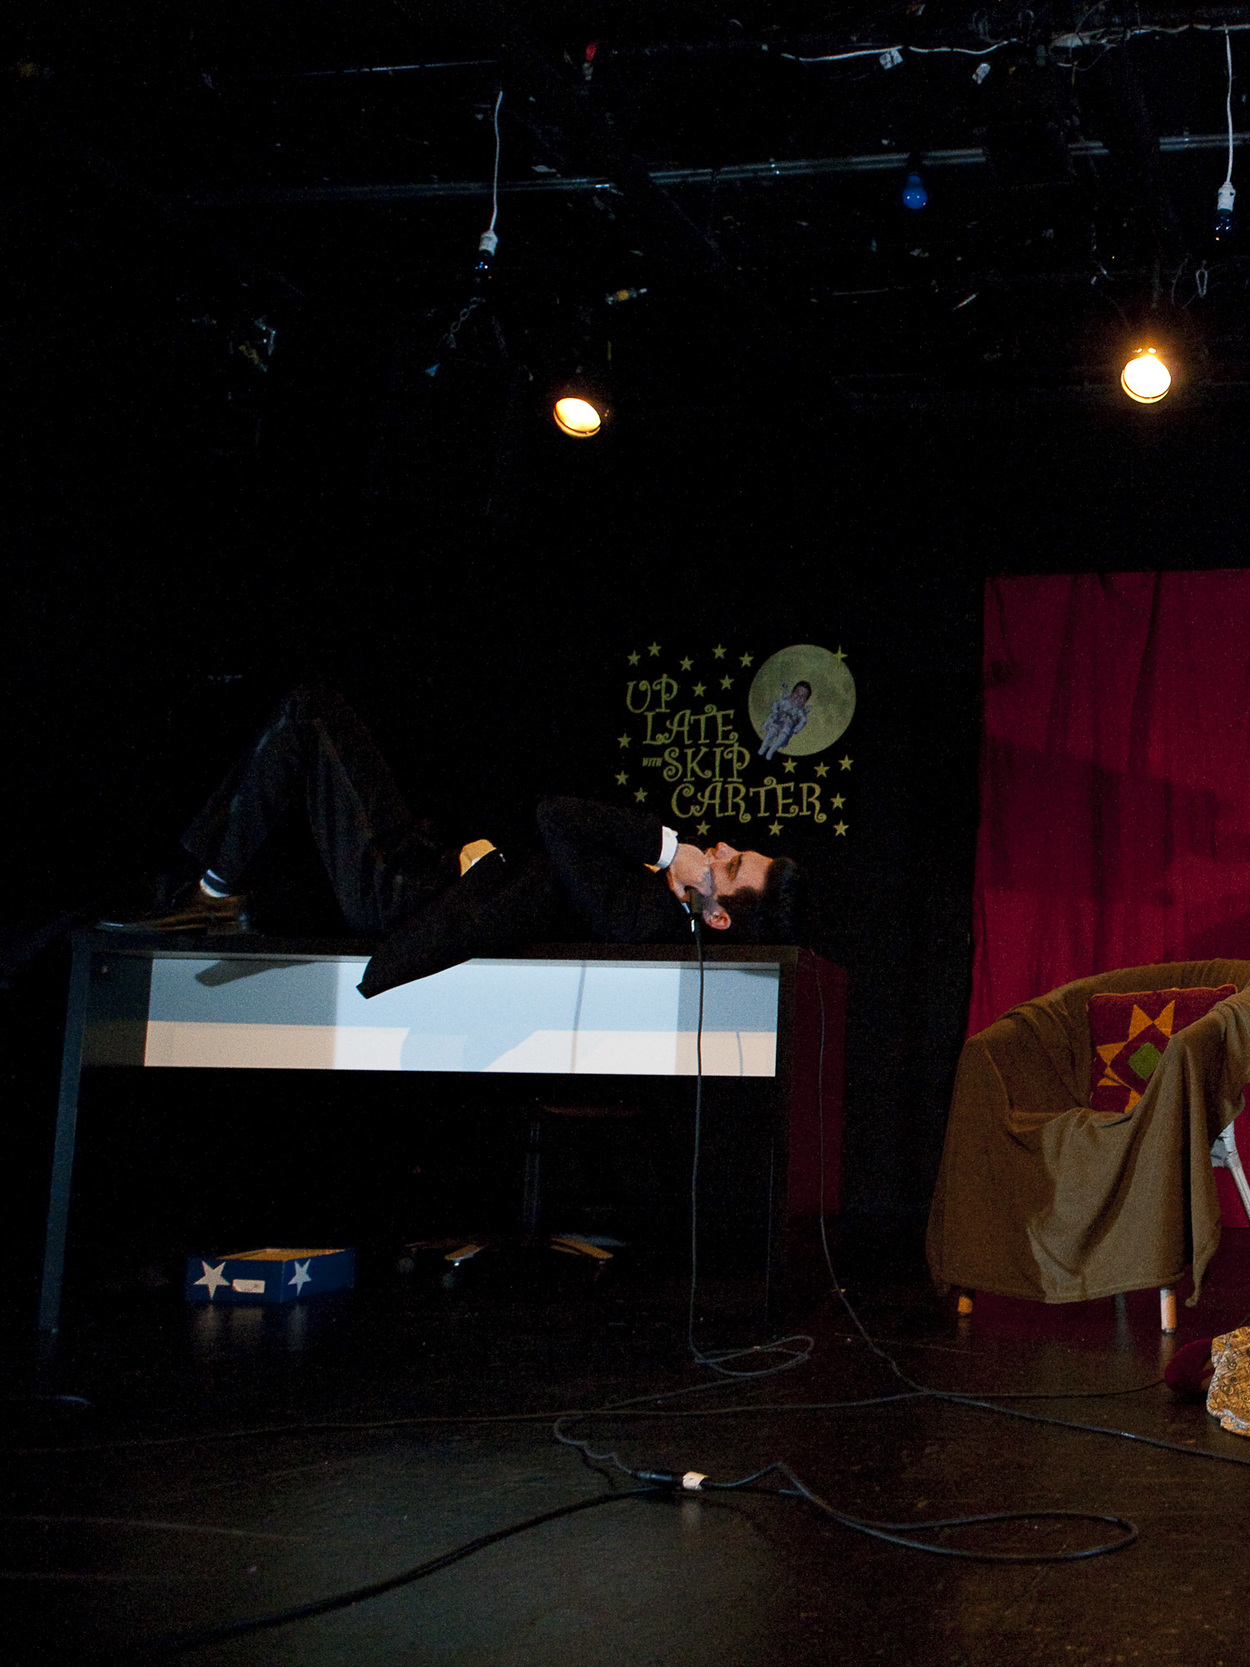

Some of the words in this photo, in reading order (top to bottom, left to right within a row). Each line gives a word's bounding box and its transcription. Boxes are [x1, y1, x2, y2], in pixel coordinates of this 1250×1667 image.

[626, 673, 678, 714] UP
[642, 703, 739, 745] LATE
[642, 757, 662, 768] WITH
[662, 743, 751, 782] SKIP
[670, 776, 827, 824] CARTER
